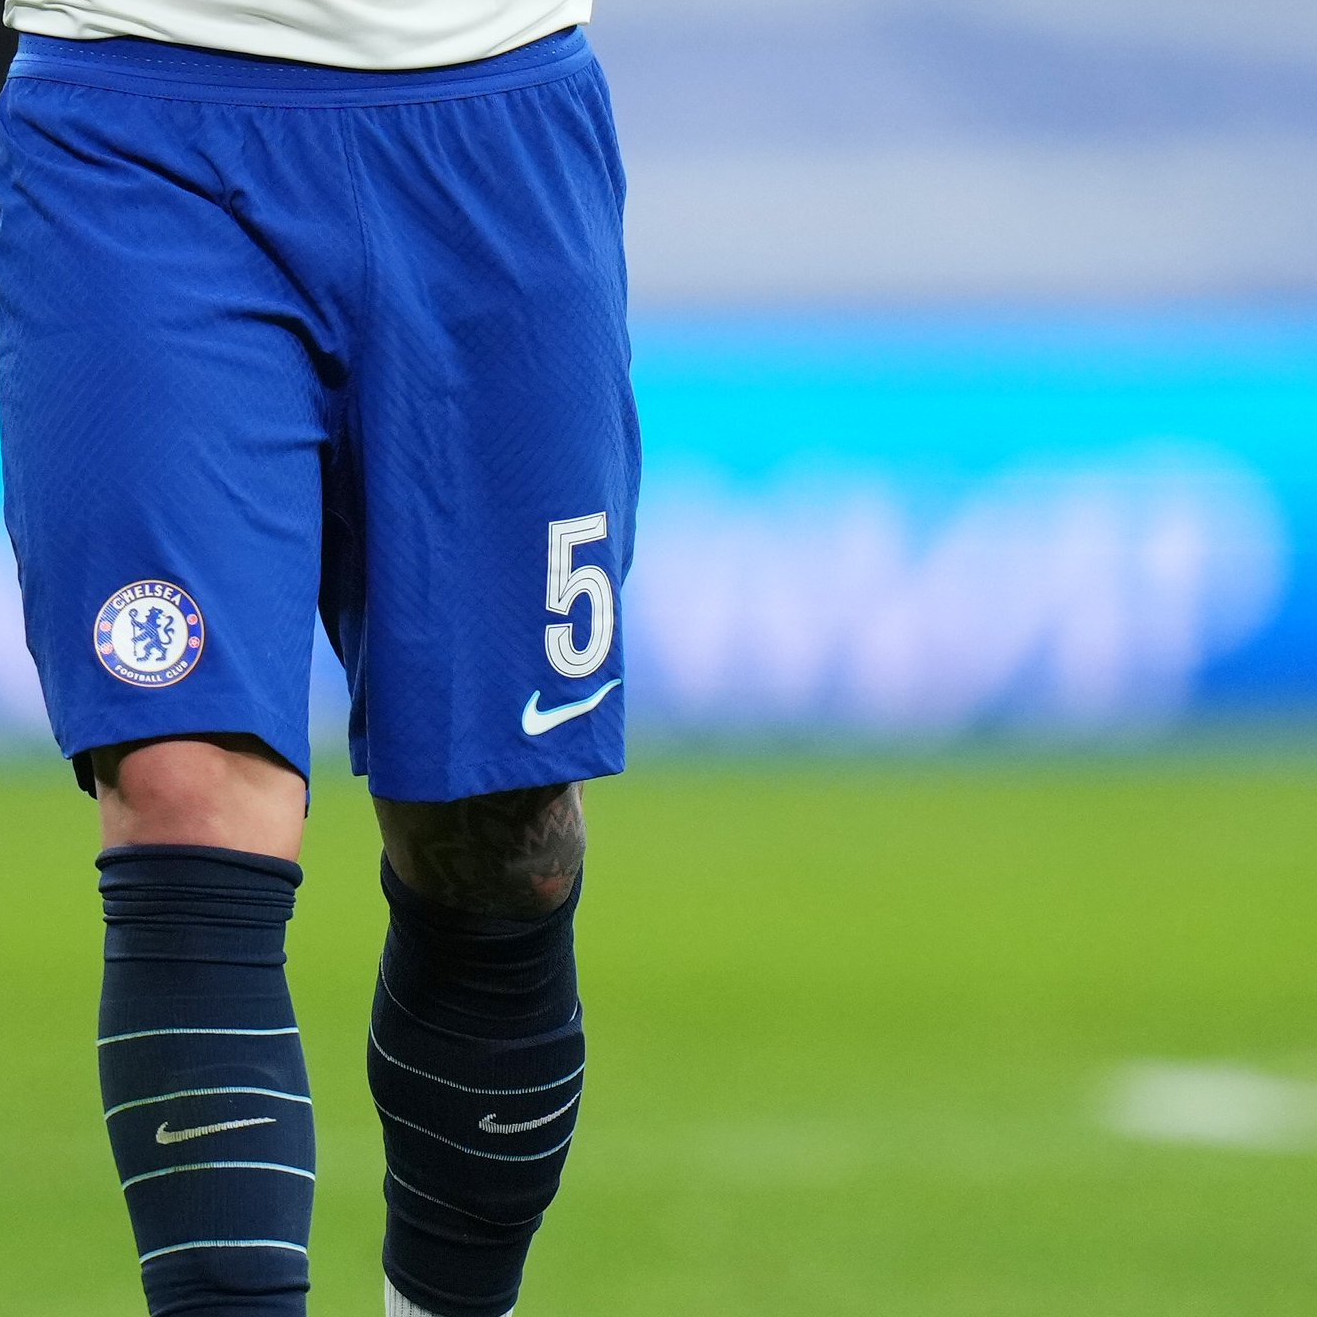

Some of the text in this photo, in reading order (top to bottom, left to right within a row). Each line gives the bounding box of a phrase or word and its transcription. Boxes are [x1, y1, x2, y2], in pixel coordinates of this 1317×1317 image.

[112, 584, 182, 610] CHELSEA
[544, 511, 615, 678] 5
[114, 661, 189, 682] FOOTBALL CLUB
